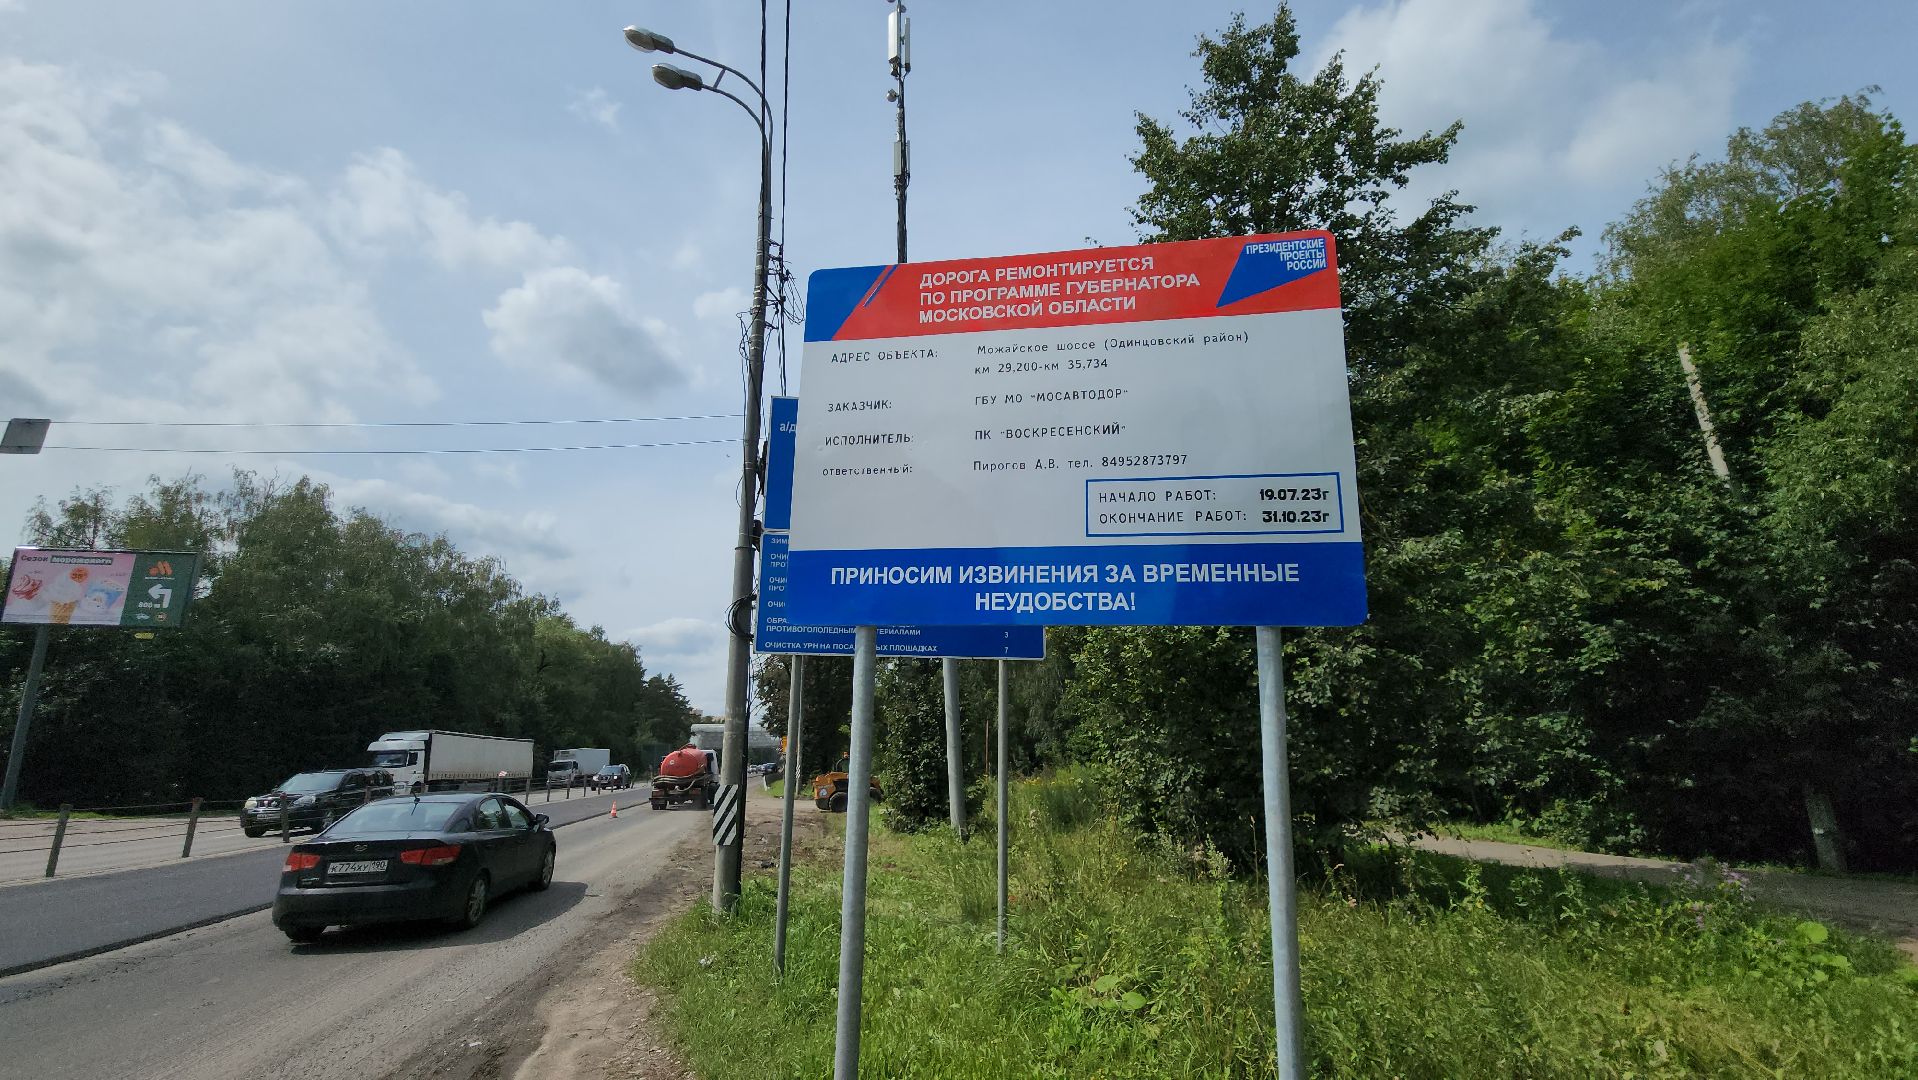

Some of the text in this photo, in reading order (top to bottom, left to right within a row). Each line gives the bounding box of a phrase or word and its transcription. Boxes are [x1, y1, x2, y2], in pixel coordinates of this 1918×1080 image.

[1246, 238, 1324, 255] ПРЕЗИДЕНТСКИЕ
[1280, 248, 1325, 262] ПРОЕКТЫ
[1287, 258, 1326, 271] РОССИИ
[920, 257, 1154, 289] ДОРОГА РЕМОНТИРУЕТСЯ
[920, 273, 1200, 306] ПО ПРОГРАММЕ ГУБЕРНАТОРА
[919, 296, 1136, 323] МОСКОВСКОЙ ОБЛАСТИ
[977, 331, 1249, 355] Можайское шоссе (Одинцовский район)
[831, 349, 939, 363] АДРЕС ОБЪЕКТА:
[974, 366, 990, 375] км
[1067, 358, 1108, 371] 35,734
[828, 400, 893, 413] ЗАКАЗЧИК:
[975, 395, 996, 406] ГБУ
[1004, 394, 1023, 403] МО
[825, 433, 914, 446] ИСПОЛНИТЕЛЬ:
[975, 429, 991, 440] ПК
[973, 454, 1188, 473] Пирогов А.В. тел. 84952873797
[1099, 488, 1330, 503] НАЧАЛО РАБОТ: 19.07.23г
[1099, 510, 1330, 524] ОКОНЧАНИЕ РАБОТ: 31.10.23г
[831, 563, 1299, 585] ПРИНОСИМ ИЗВИНЕНИЯ ЗА ВРЕМЕННЫЕ
[975, 592, 1136, 613] НЕУДОБСТВА!
[766, 625, 856, 634] ПРОТИВОГОЛОЛЕДНЫМ
